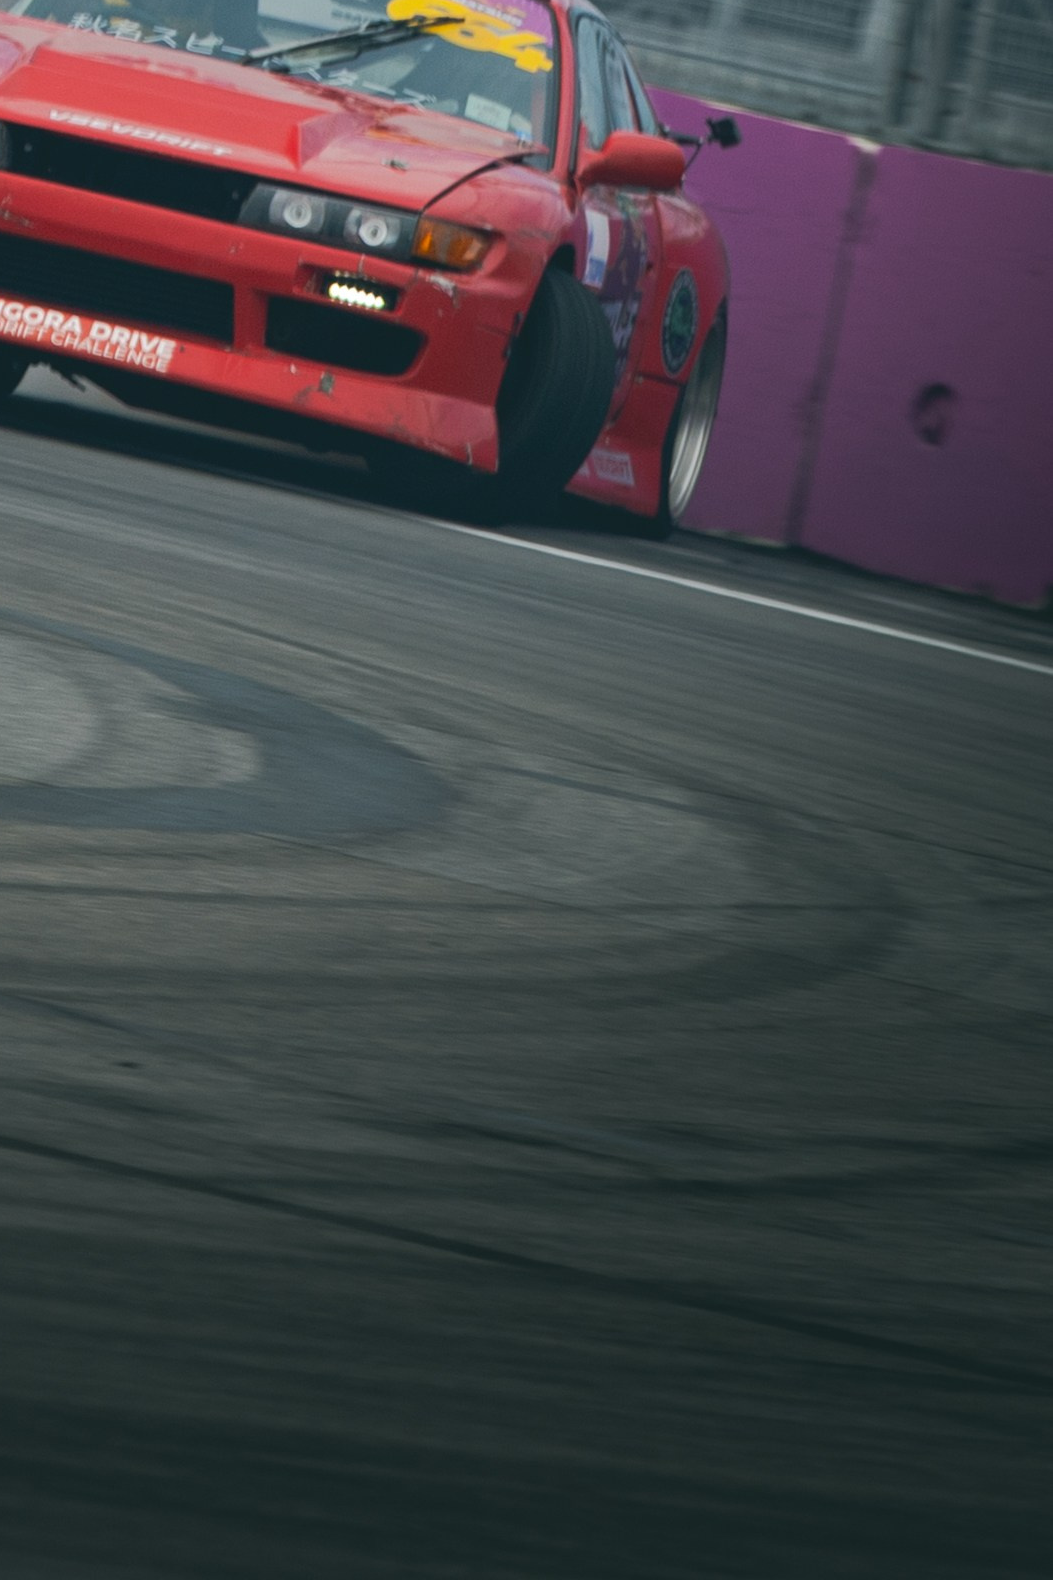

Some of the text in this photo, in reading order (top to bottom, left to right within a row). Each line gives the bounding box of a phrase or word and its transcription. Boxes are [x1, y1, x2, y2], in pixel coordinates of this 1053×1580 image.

[50, 108, 232, 157] VSEVDRIFT
[50, 330, 171, 374] CHALLENGE
[89, 321, 177, 360] DRIVE
